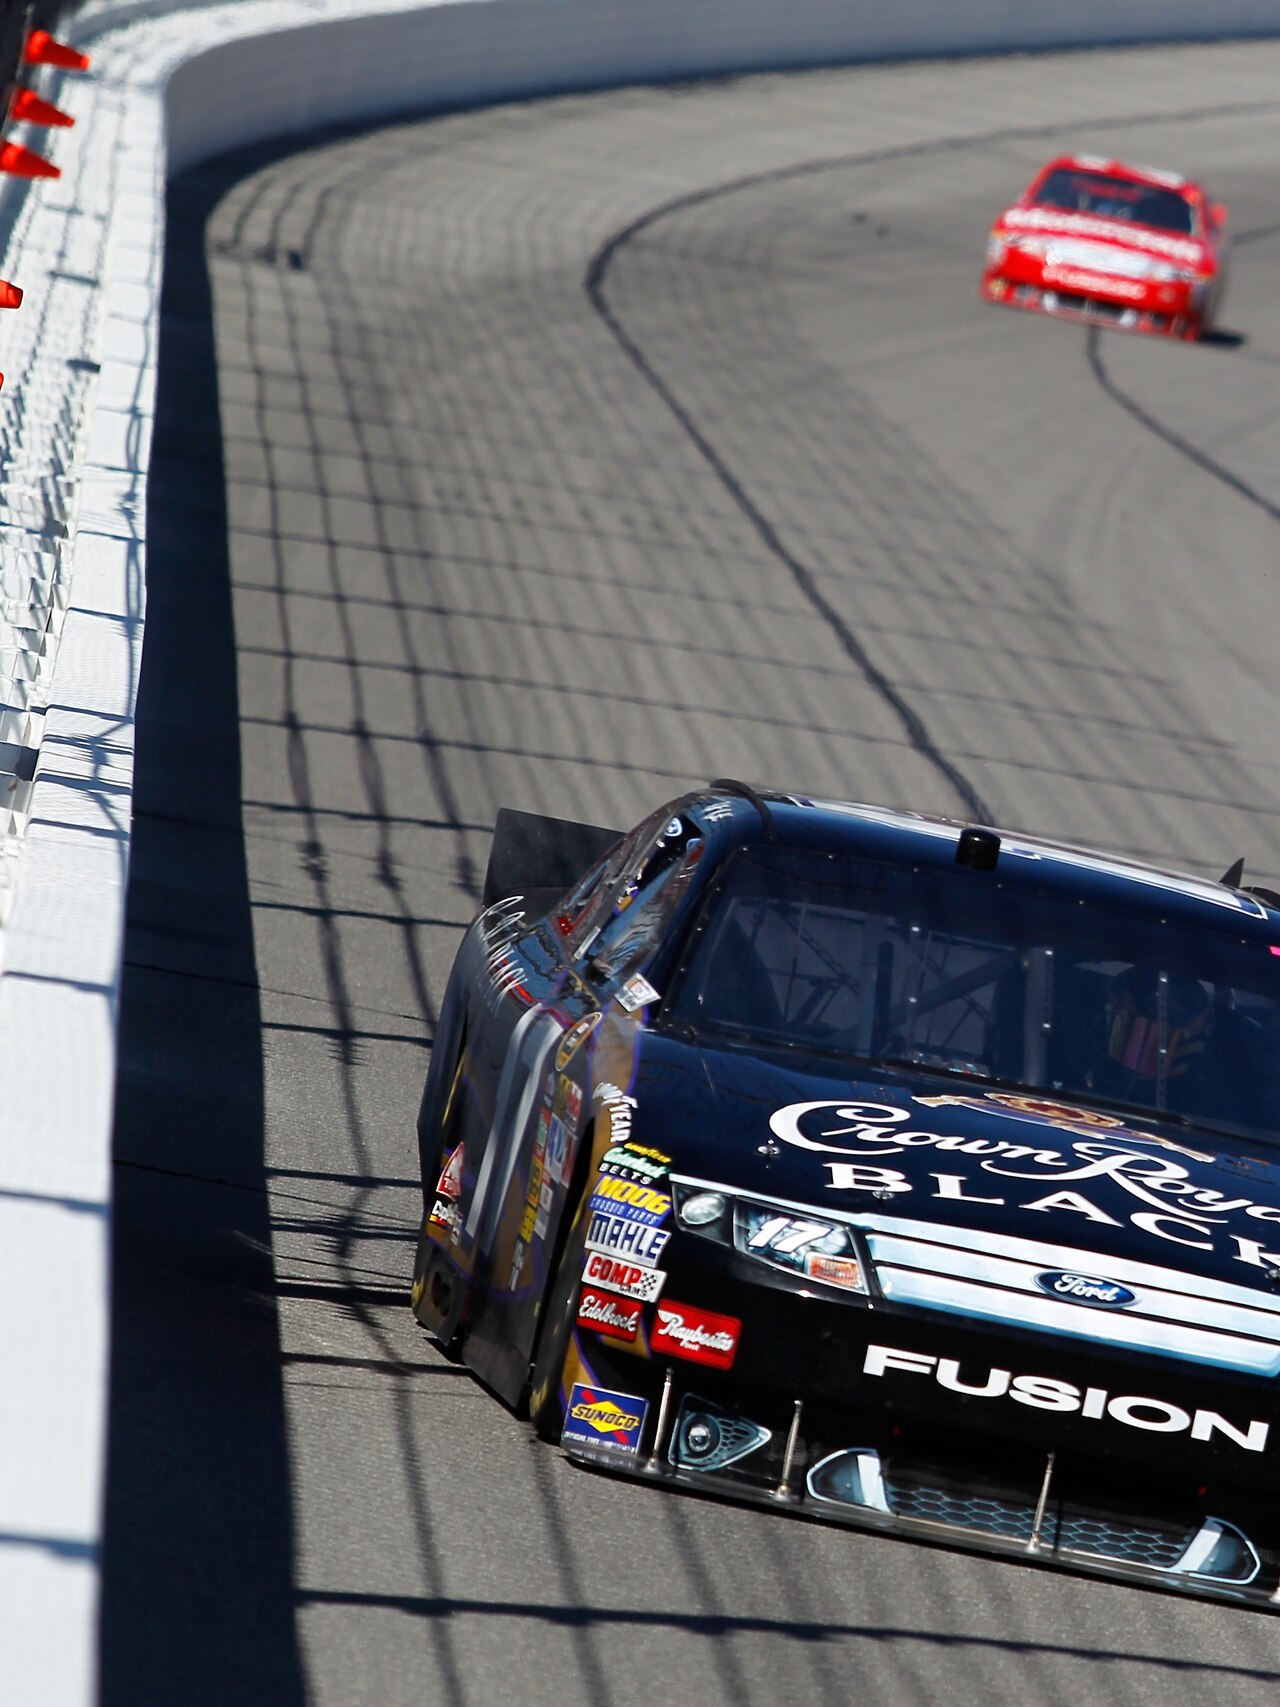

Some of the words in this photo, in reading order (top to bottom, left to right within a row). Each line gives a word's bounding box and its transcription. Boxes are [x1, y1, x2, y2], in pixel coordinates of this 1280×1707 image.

[592, 1082, 639, 1143] DYEAR
[769, 1100, 1068, 1165] Crown
[598, 1162, 653, 1185] BELTS
[593, 1175, 672, 1216] MOOG
[588, 1212, 668, 1260] MAHLE
[747, 1216, 834, 1255] 17
[588, 1256, 641, 1286] COMP
[1053, 1274, 1119, 1302] Ford
[619, 1284, 648, 1298] CAMS
[579, 1295, 640, 1332] Edelbrock
[657, 1309, 736, 1352] Raybestos
[574, 1406, 638, 1429] SUNOCO
[863, 1344, 1270, 1452] FUSION
